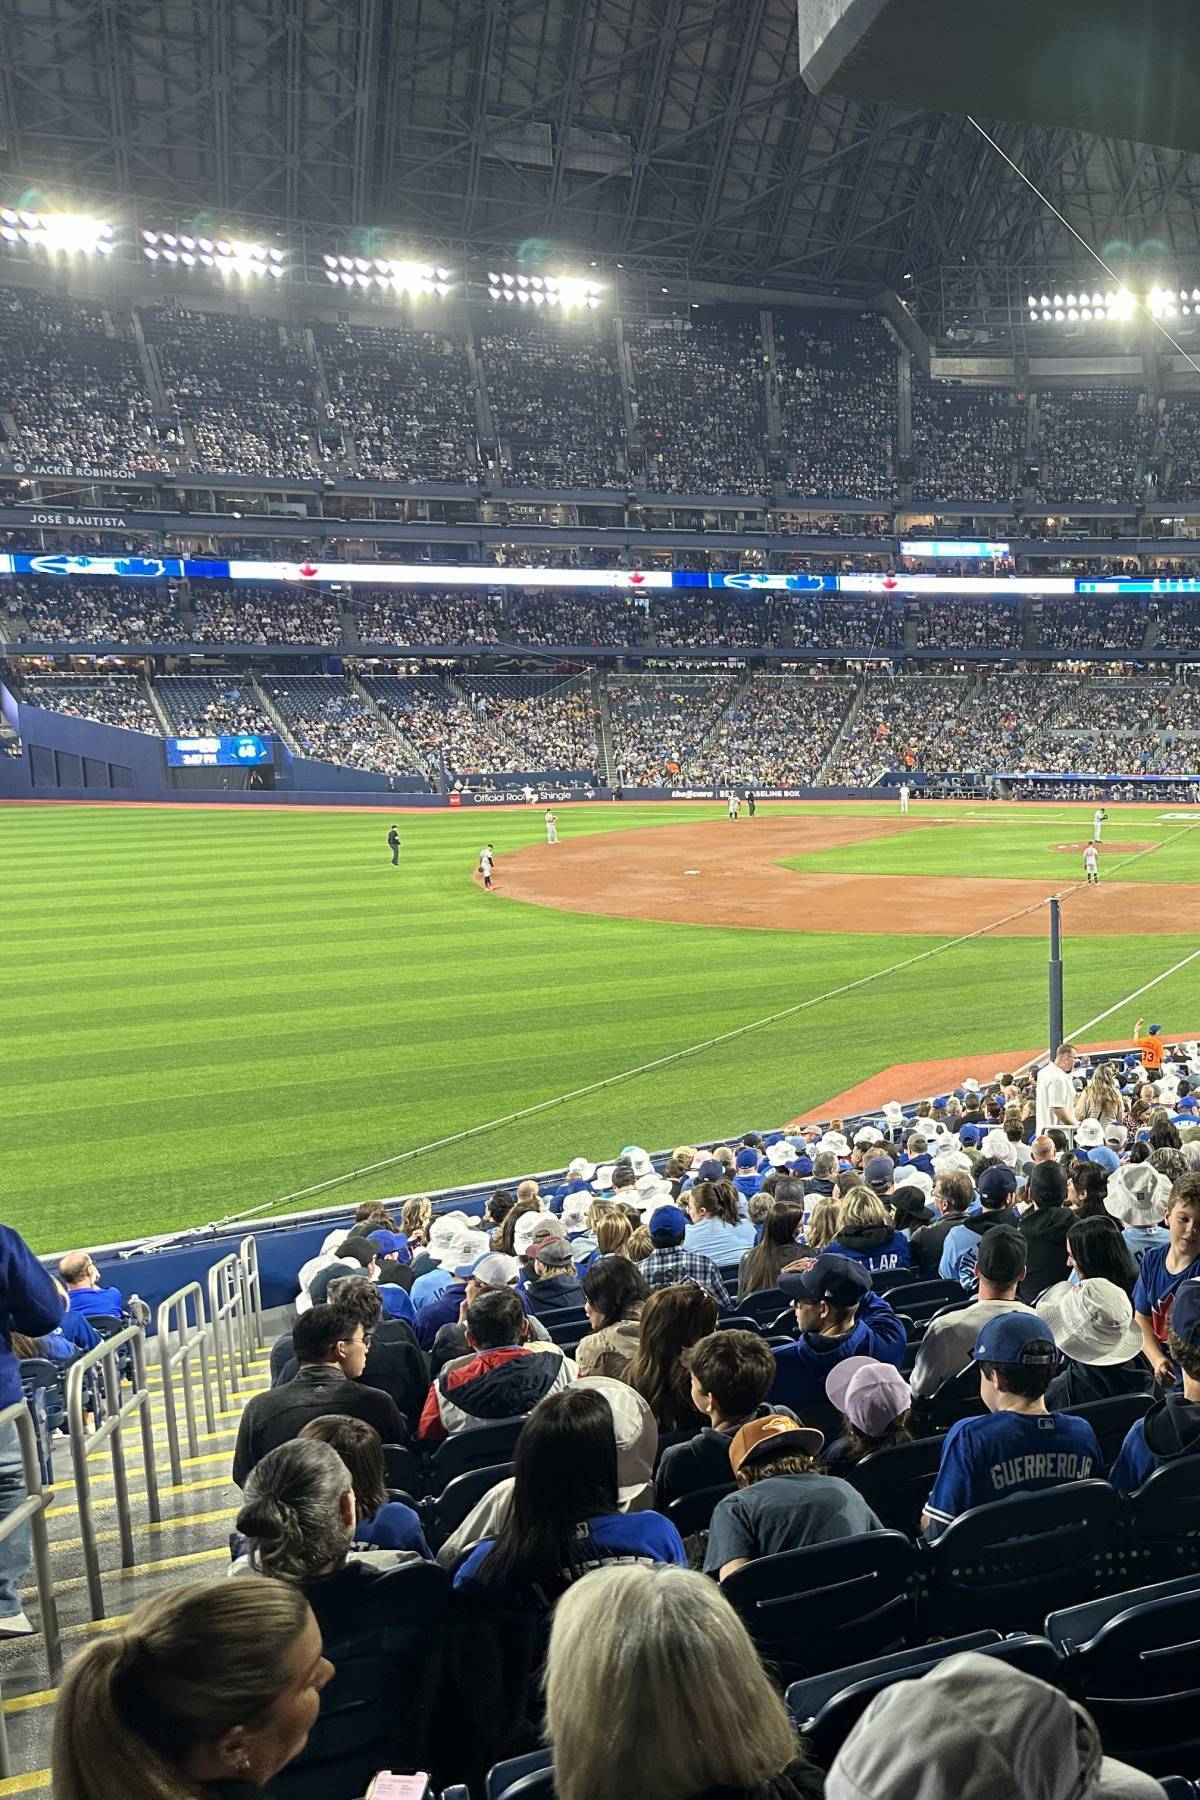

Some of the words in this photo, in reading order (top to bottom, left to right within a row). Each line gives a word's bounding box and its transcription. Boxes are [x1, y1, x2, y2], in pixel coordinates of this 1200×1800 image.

[32, 465, 72, 475] JACKIE
[76, 468, 136, 479] ROBINSON
[68, 516, 126, 527] BAUTISTA
[474, 794, 504, 803] Official
[540, 791, 571, 801] Shingle
[671, 790, 713, 798] theScore
[991, 1453, 1078, 1490] GUERRERO
